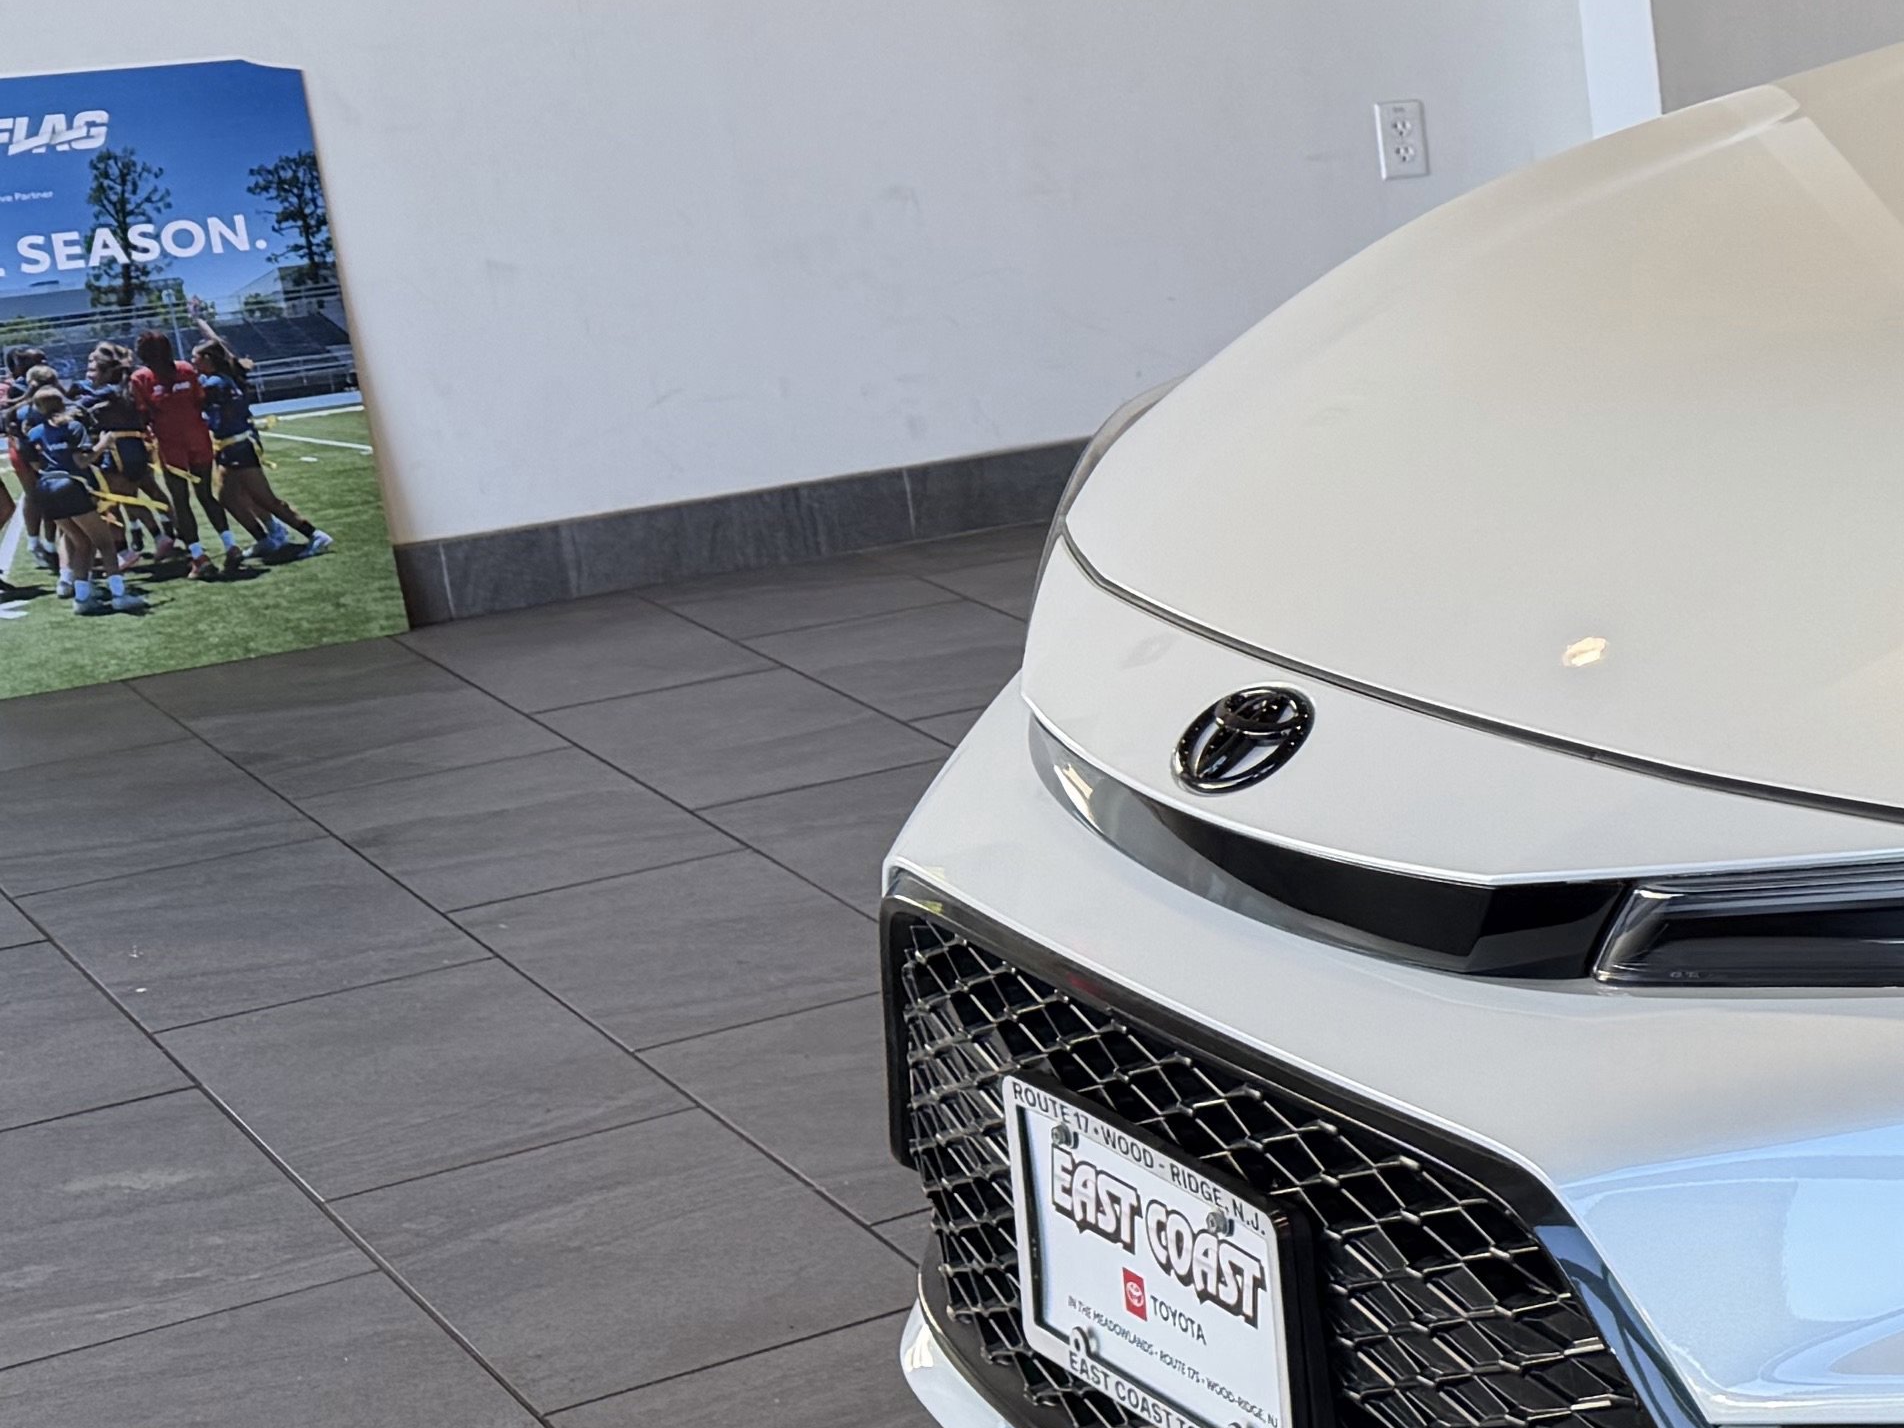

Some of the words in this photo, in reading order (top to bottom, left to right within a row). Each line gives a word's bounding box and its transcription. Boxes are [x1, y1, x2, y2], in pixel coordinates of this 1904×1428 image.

[17, 213, 267, 274] SEASON.
[1012, 1081, 1071, 1124] ROUTE
[1073, 1112, 1089, 1134] 17
[1100, 1125, 1155, 1169] WOOD
[1170, 1163, 1229, 1212] RIDGE,
[1232, 1198, 1266, 1236] N.J.
[1051, 1146, 1143, 1255] EAST
[1146, 1199, 1267, 1329] COAST
[1150, 1294, 1207, 1345] TOYOTA
[1069, 1351, 1110, 1390] EAST
[1115, 1381, 1172, 1428] COAST
[1159, 1350, 1186, 1375] ROUTE
